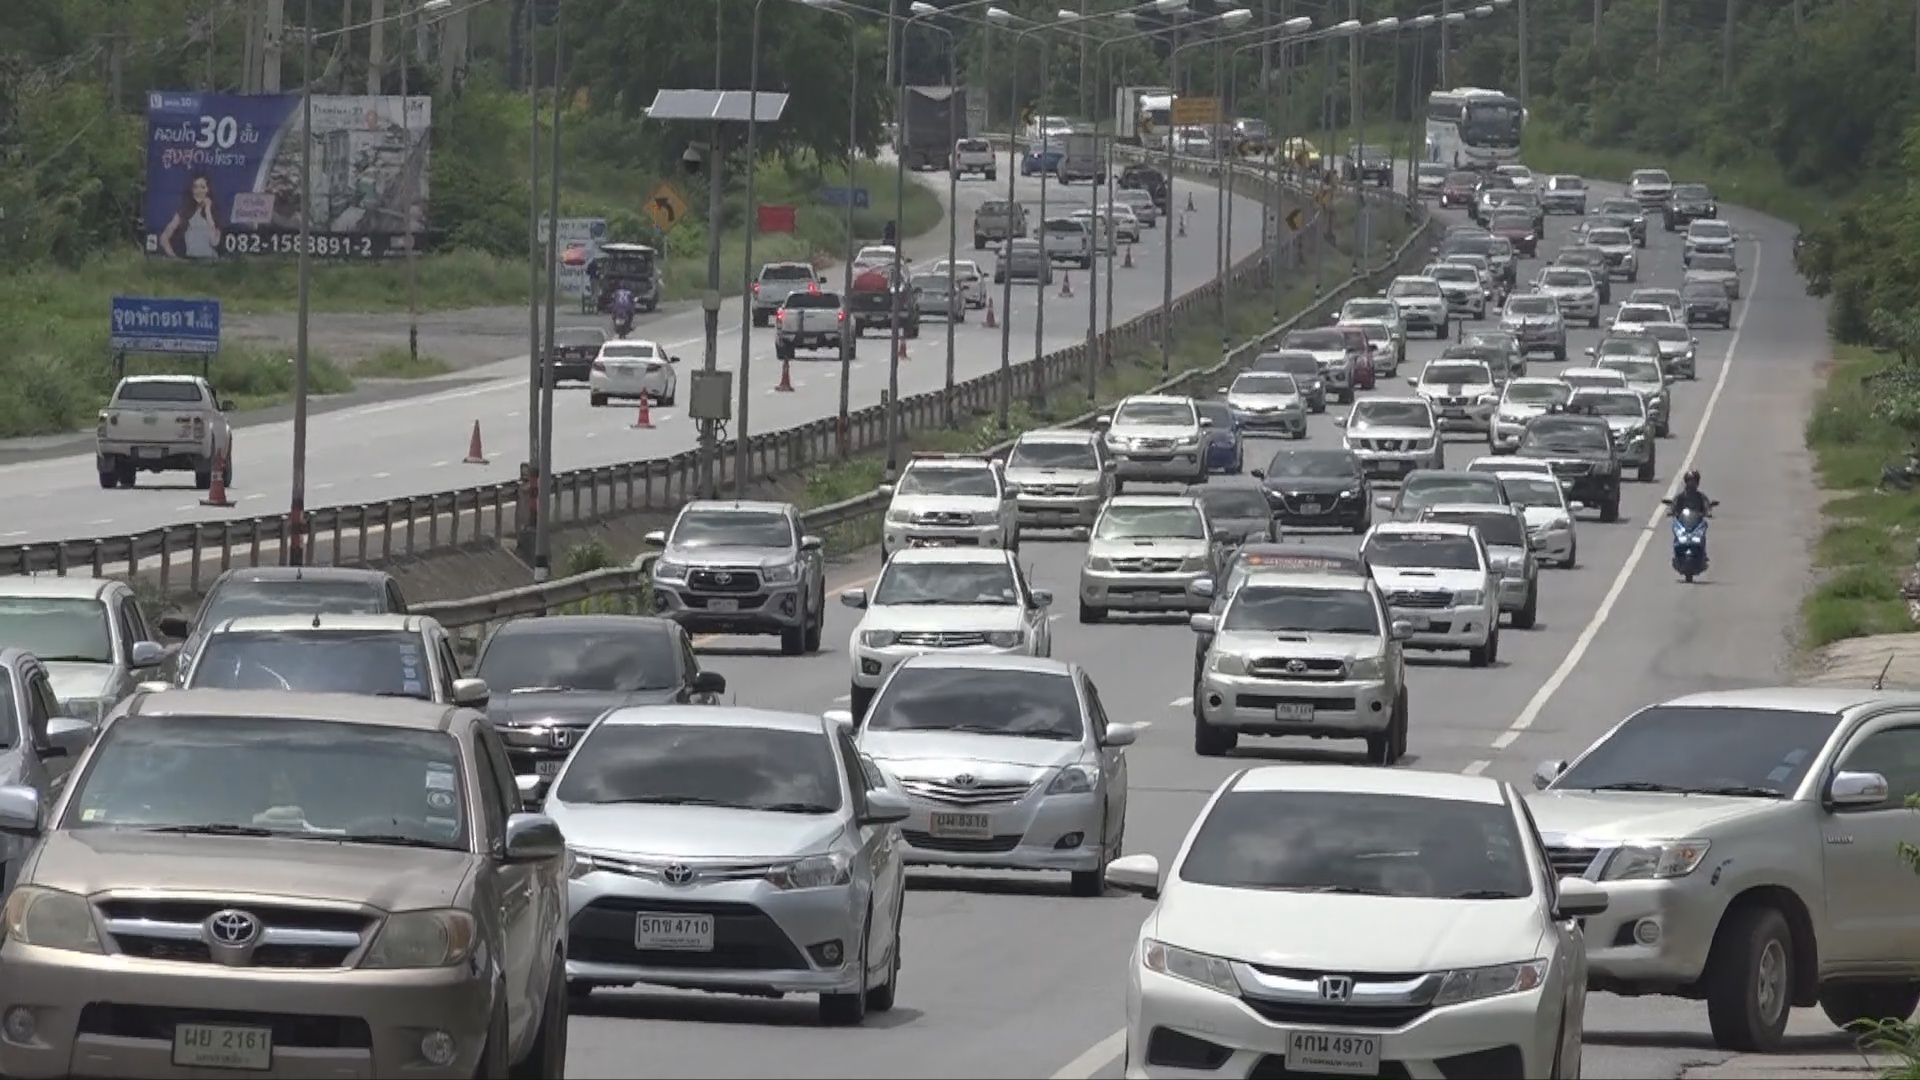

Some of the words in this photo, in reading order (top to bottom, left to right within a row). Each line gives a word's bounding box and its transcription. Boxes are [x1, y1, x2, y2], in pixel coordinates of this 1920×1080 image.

[195, 115, 238, 149] 30
[675, 919, 709, 935] 4710
[222, 1030, 267, 1050] 2161
[1332, 1037, 1374, 1056] 4970
